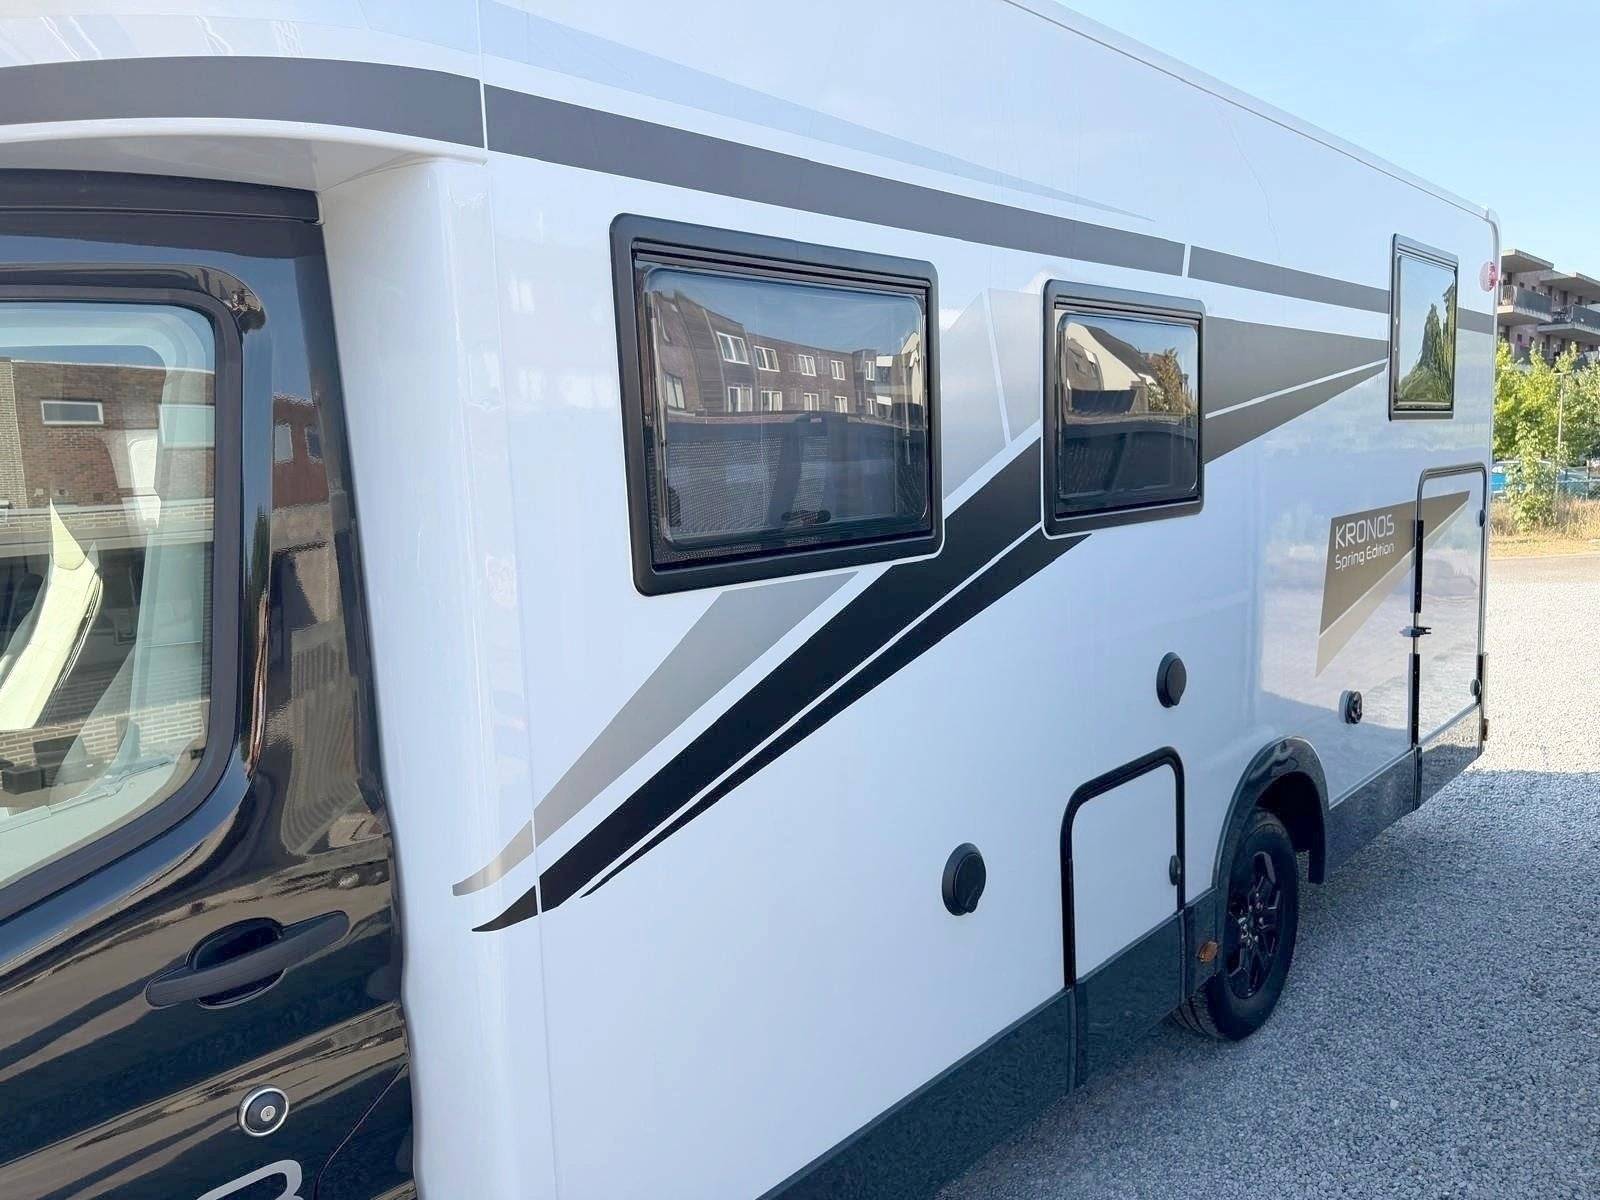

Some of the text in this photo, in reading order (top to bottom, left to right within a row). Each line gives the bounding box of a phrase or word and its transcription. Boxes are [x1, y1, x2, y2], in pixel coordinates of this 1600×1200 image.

[1335, 514, 1395, 550] KRONOS
[1335, 543, 1395, 571] Spring Edition
